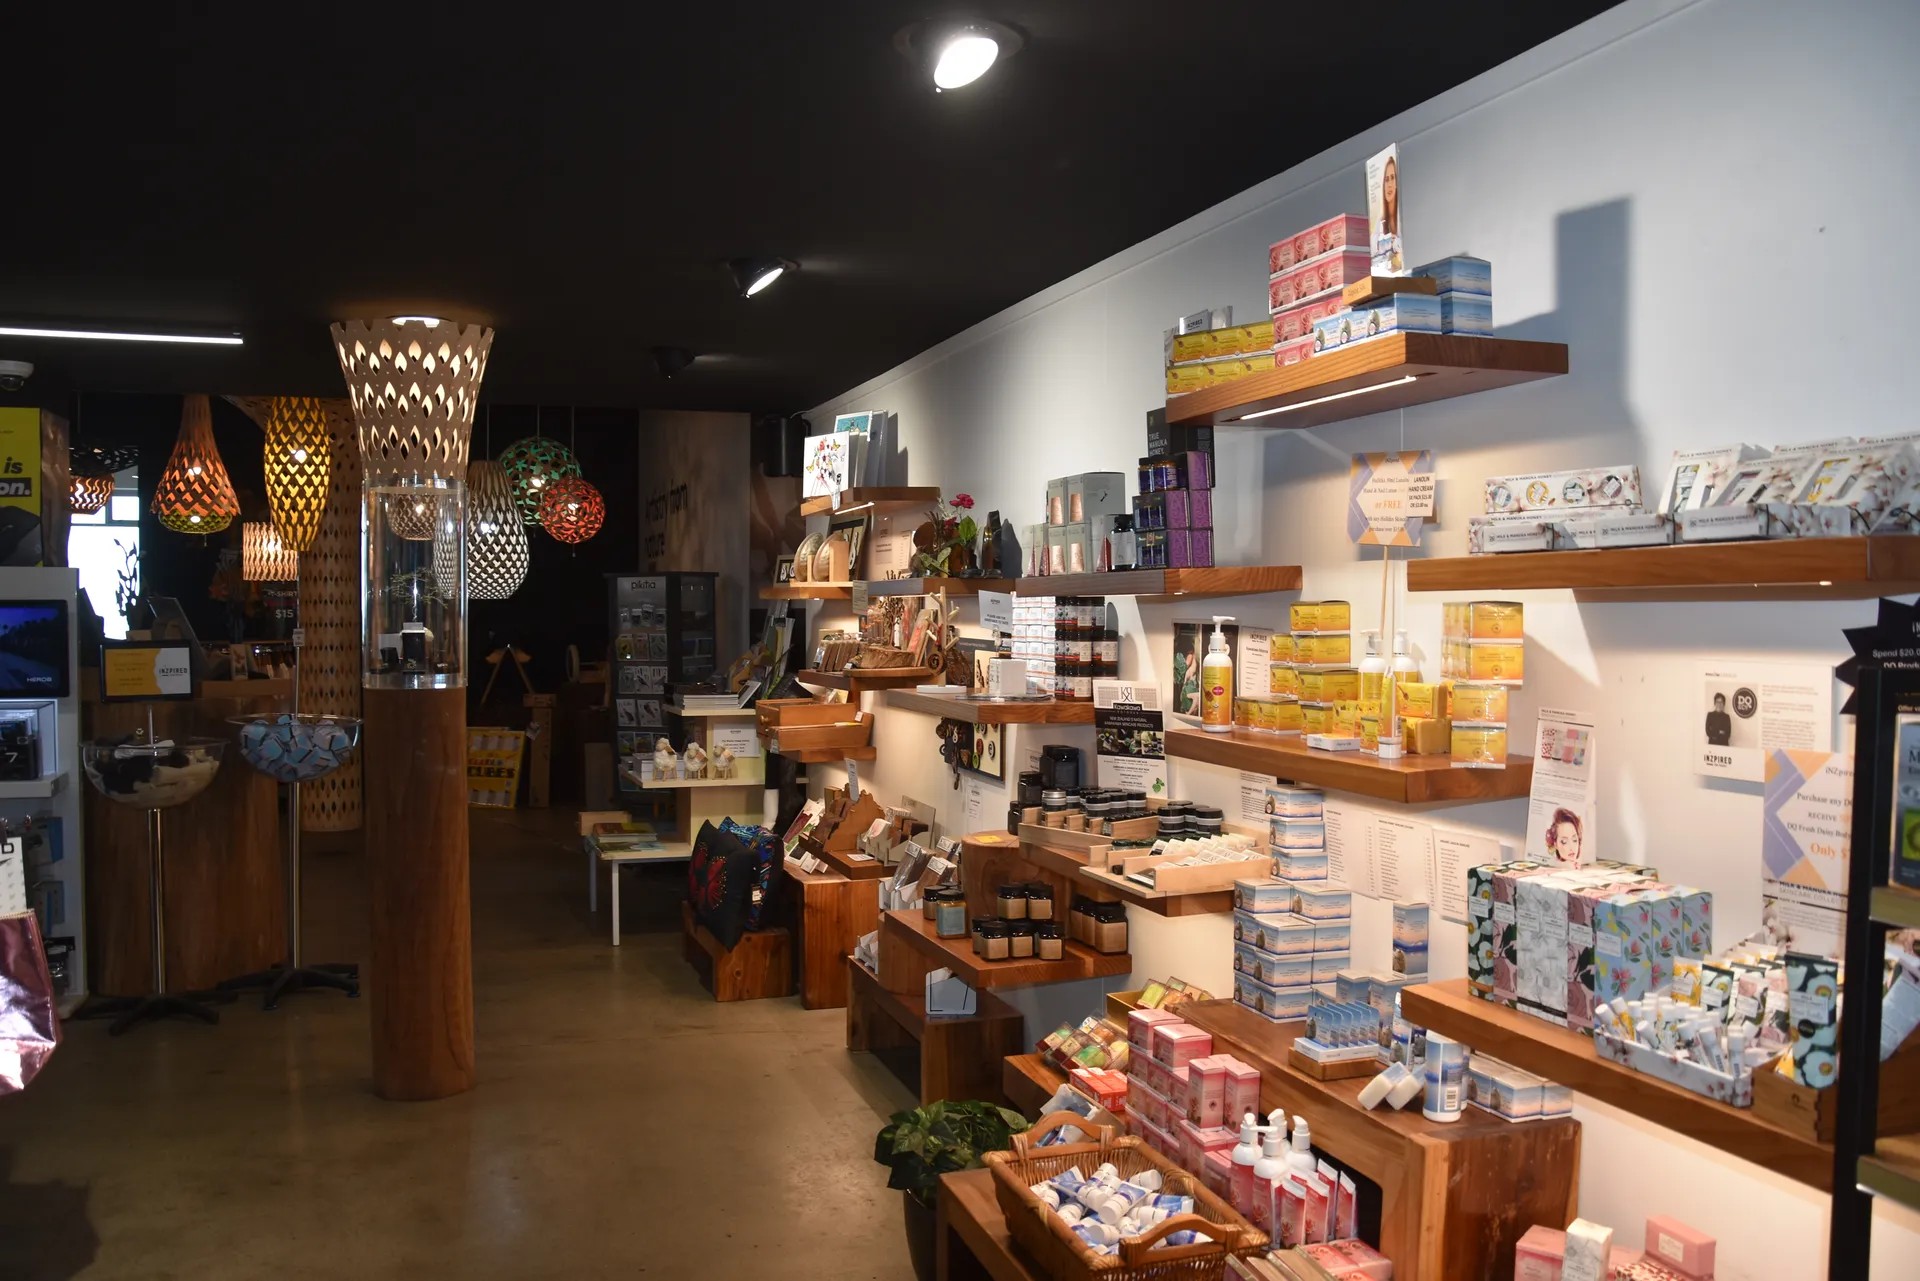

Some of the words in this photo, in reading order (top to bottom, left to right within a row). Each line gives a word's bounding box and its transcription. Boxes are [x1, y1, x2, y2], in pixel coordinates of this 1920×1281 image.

[4, 457, 23, 474] is
[1420, 484, 1434, 492] CREAM
[275, 608, 294, 619] $15
[1872, 649, 1898, 659] Spend
[5, 752, 18, 763] 7
[1825, 766, 1853, 777] iNZpire
[1797, 792, 1828, 804] Purchase
[1808, 811, 1837, 821] RECEIVE
[1787, 822, 1797, 831] DQ
[1798, 823, 1815, 833] Fresh
[1811, 842, 1836, 859] Only
[1779, 881, 1795, 889] MILK
[1802, 885, 1832, 896] MANUKA
